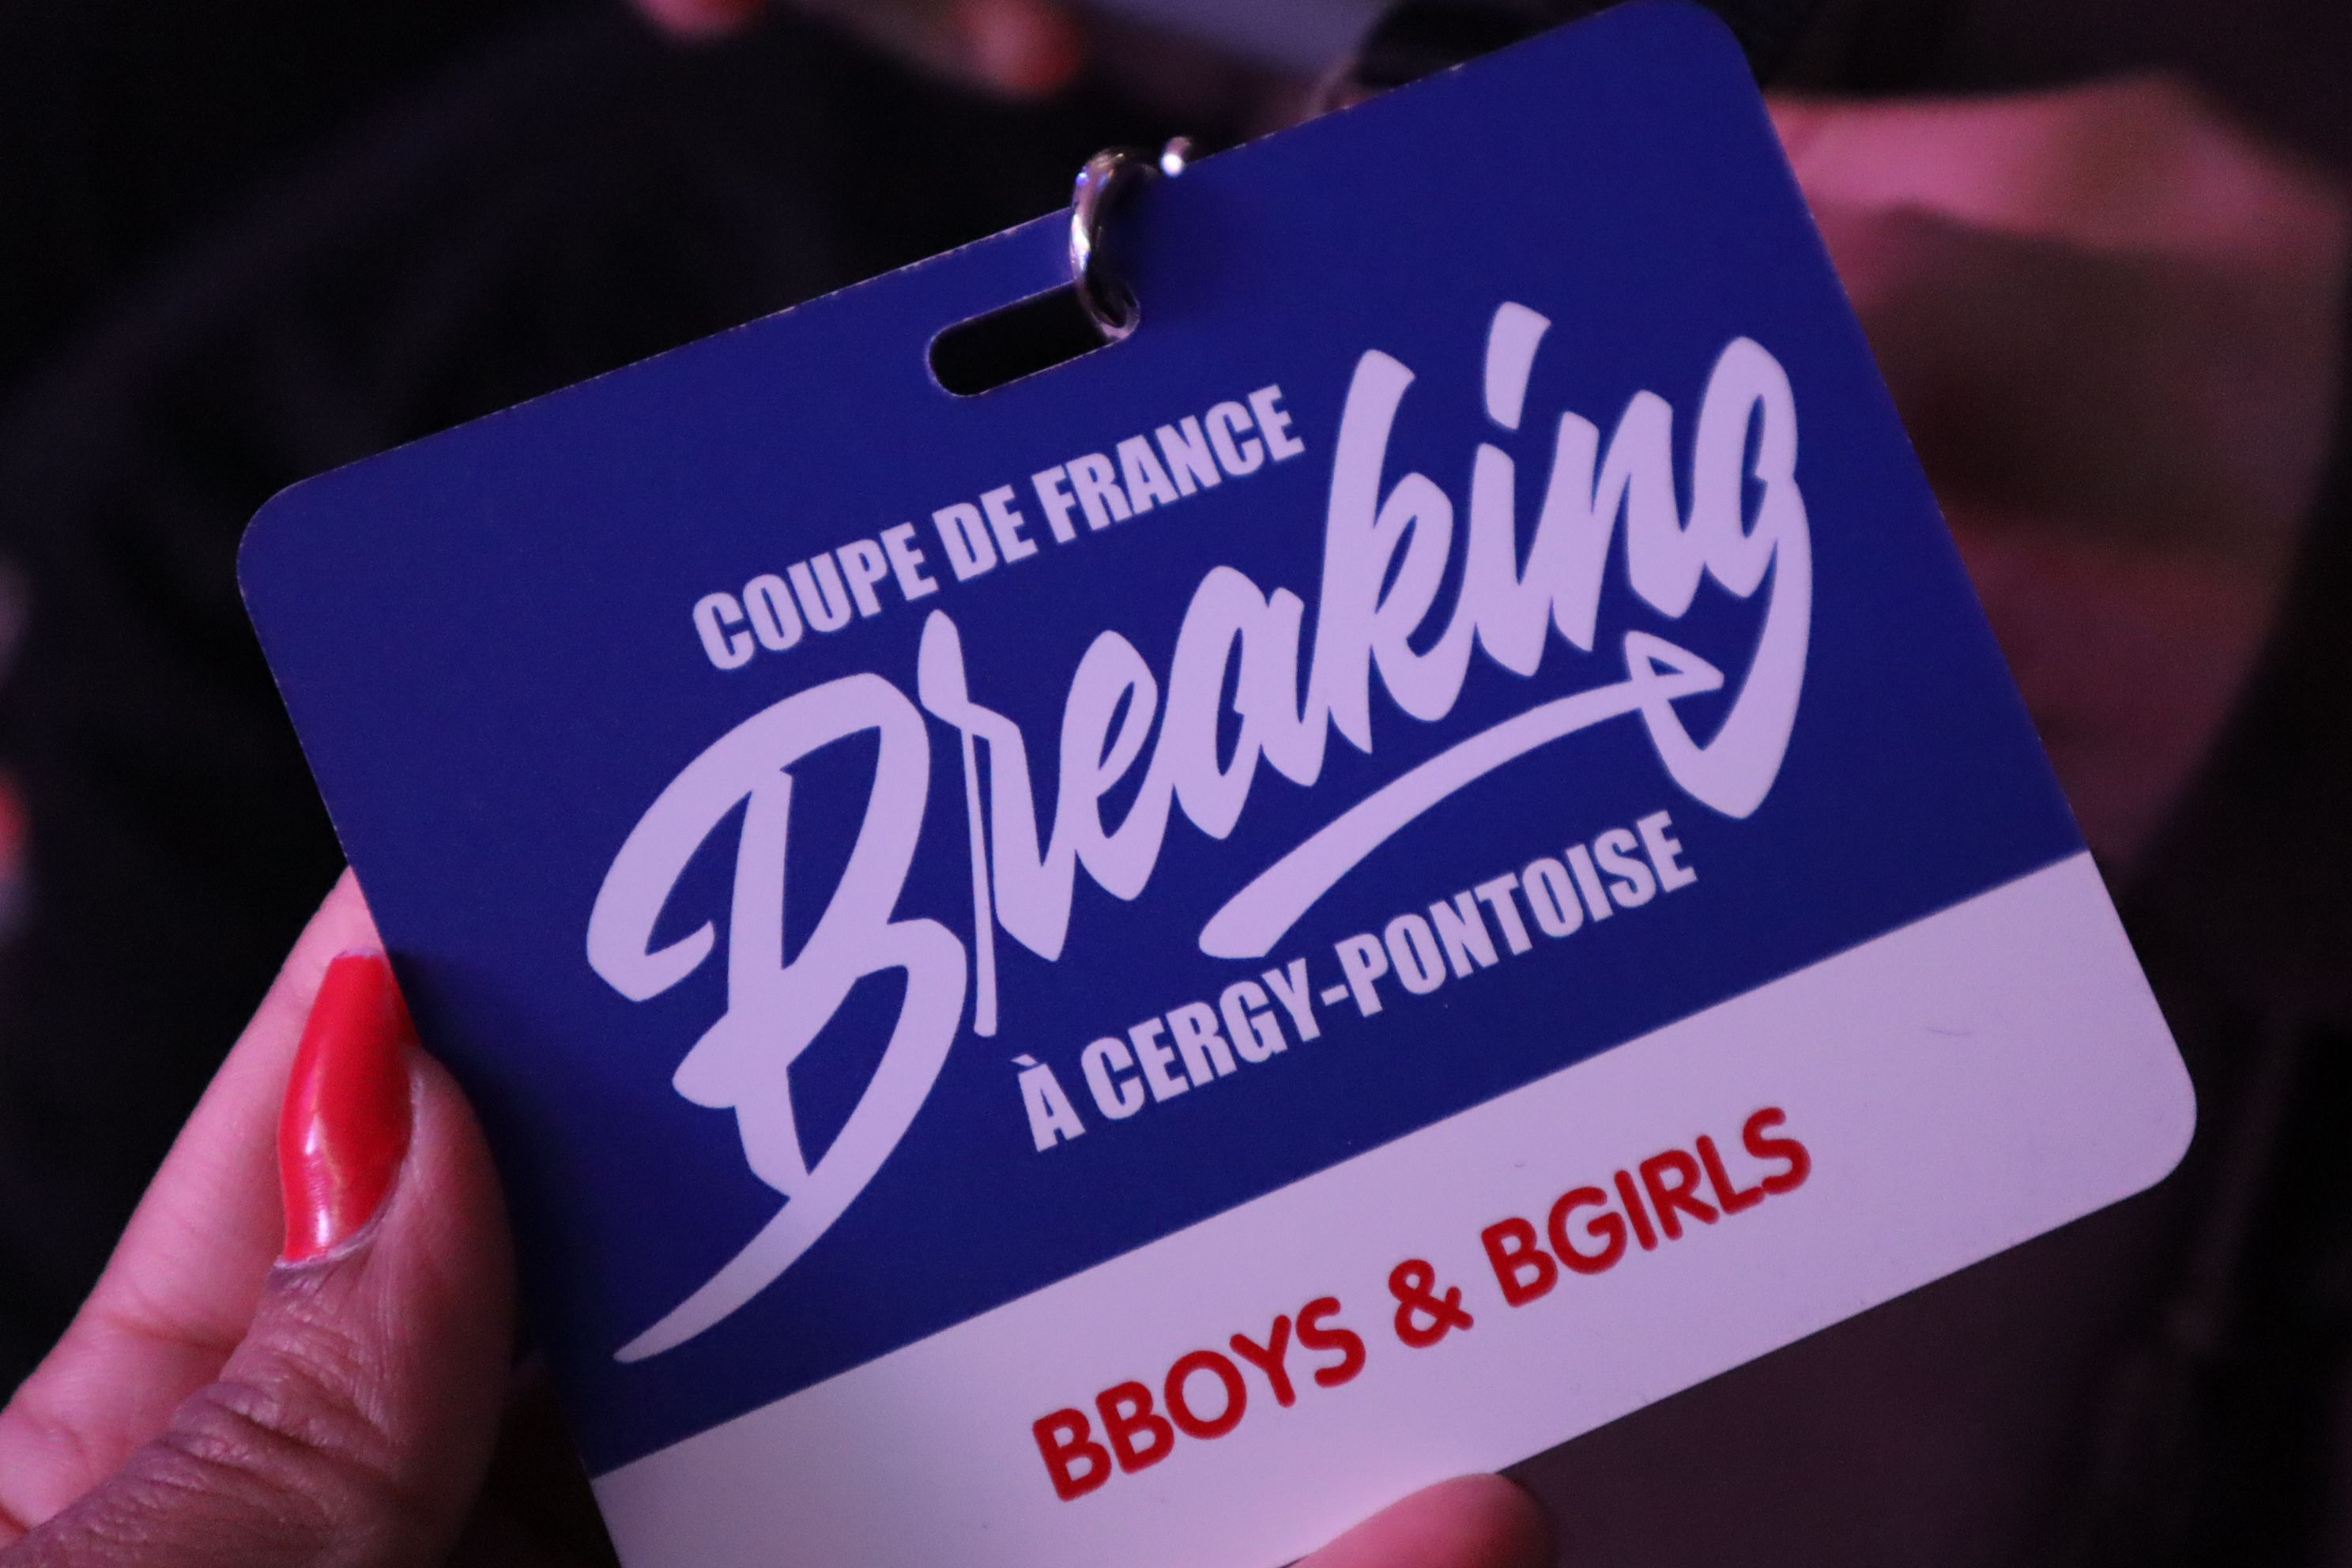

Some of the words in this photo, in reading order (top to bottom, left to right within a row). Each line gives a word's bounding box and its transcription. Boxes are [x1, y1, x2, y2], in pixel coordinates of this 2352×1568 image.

[692, 521, 939, 670] COUPE
[932, 484, 1038, 582] DE
[1031, 383, 1305, 544] FRANCE
[586, 301, 1812, 1363] Breaking
[1012, 1053, 1085, 1152] À
[1080, 810, 1697, 1121] CERGY-PONTOISE
[1031, 1295, 1366, 1502] BBOYS
[1388, 1258, 1475, 1348] &
[1480, 1106, 1812, 1308] BGIRLS
